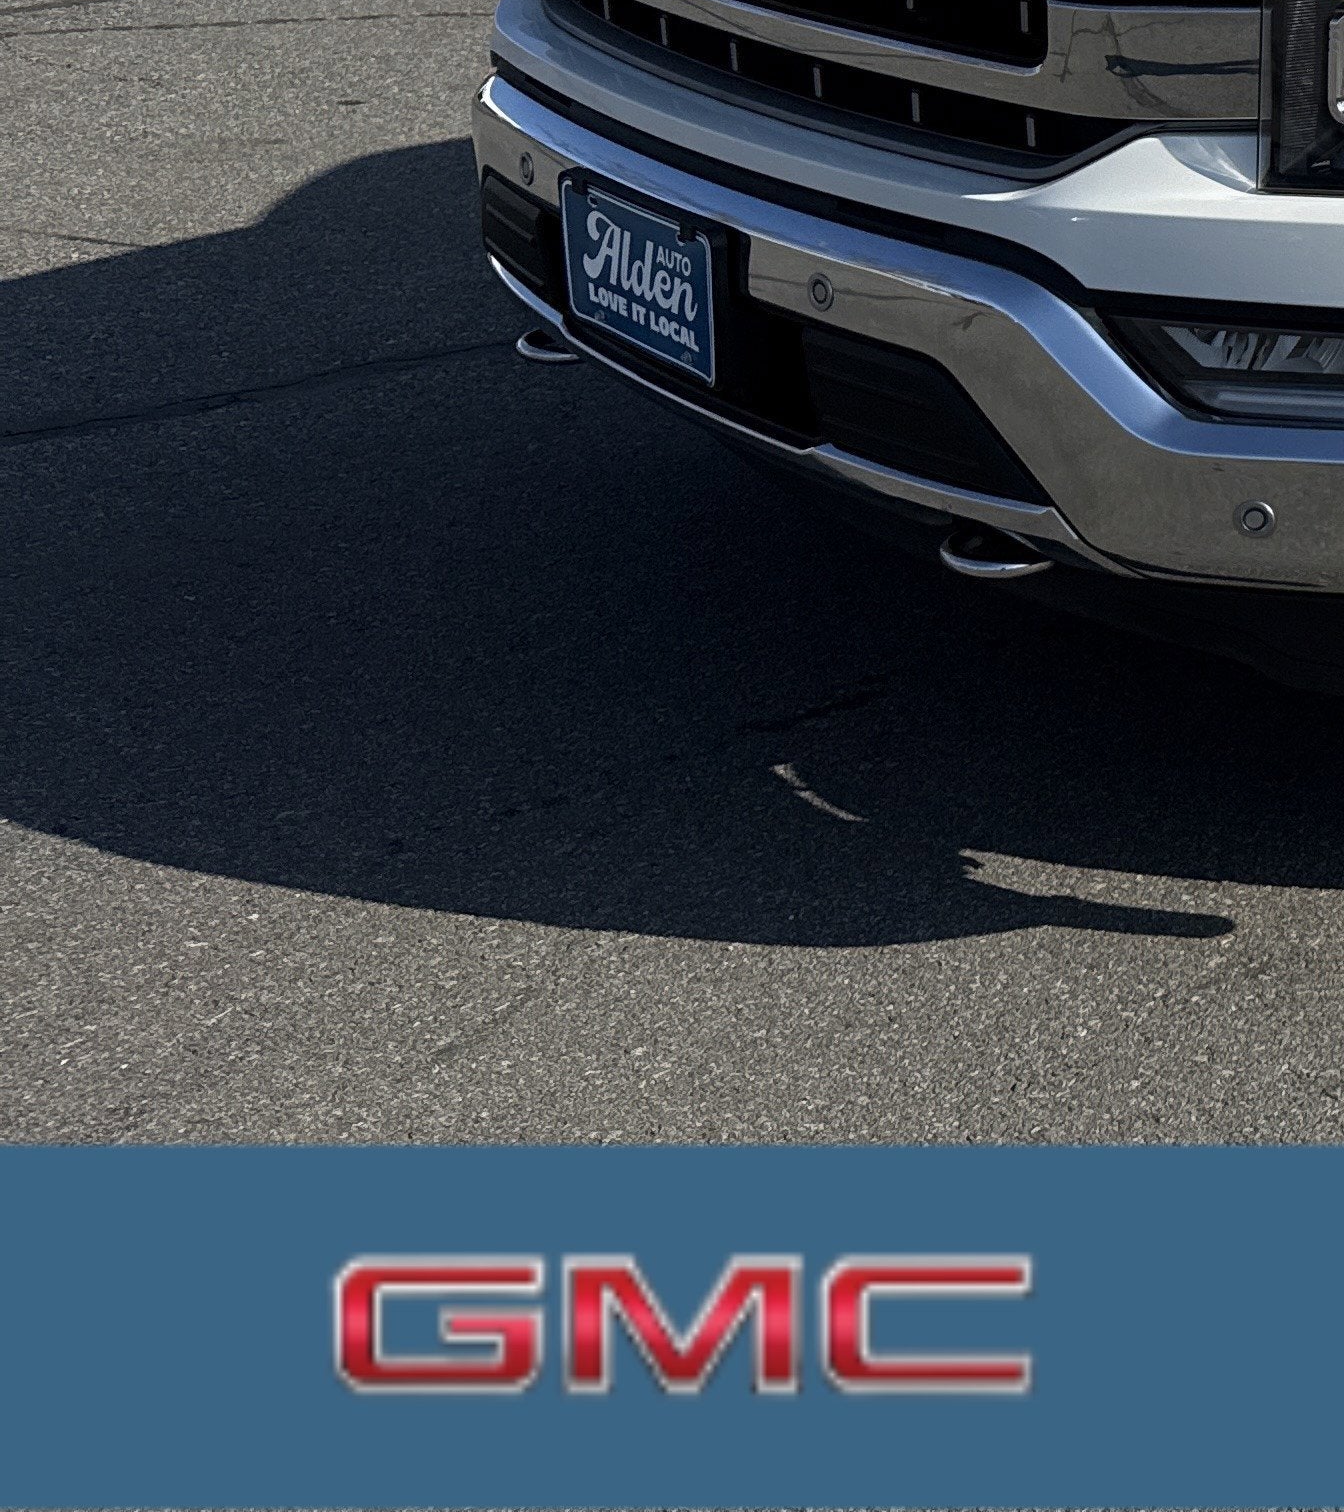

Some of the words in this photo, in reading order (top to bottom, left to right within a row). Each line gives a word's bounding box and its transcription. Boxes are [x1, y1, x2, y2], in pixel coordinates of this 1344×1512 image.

[582, 209, 698, 322] Alden
[655, 245, 692, 278] AUTO
[587, 282, 628, 318] LOVE
[631, 307, 647, 326] IT
[650, 310, 700, 354] LOCAL
